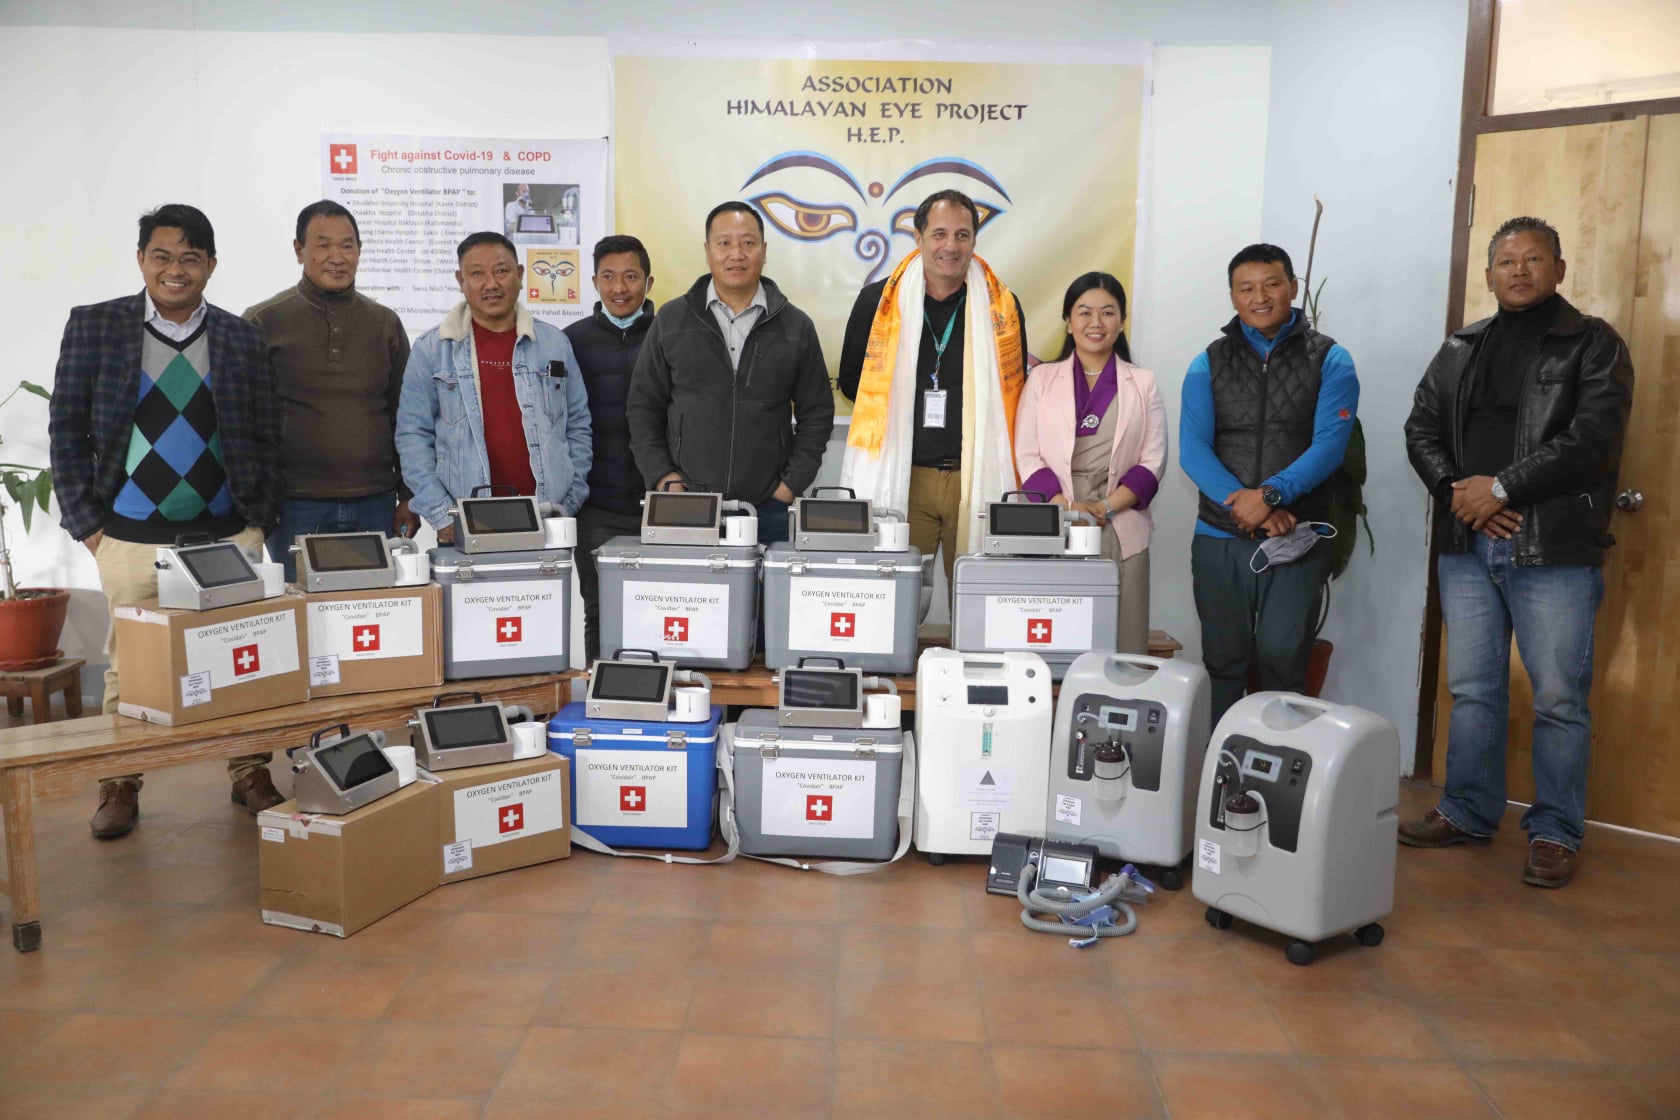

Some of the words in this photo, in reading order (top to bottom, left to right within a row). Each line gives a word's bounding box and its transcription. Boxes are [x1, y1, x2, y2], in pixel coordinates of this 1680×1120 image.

[801, 76, 952, 95] ASSOCIATION
[727, 100, 867, 118] HIMALAYAN
[881, 102, 923, 120] EYE
[936, 103, 1028, 123] PROJECT
[847, 127, 904, 144] H.E.P.
[370, 150, 399, 162] Fight
[401, 150, 440, 162] against
[444, 150, 493, 161] Covid-19
[504, 152, 511, 162] &
[518, 152, 551, 162] COPD
[382, 166, 412, 174] Chronic
[414, 166, 458, 175] obstructive
[460, 166, 502, 176] pulmonary
[504, 167, 536, 175] disease
[382, 188, 408, 196] "Oxygen
[318, 603, 350, 612] OXYGEN
[353, 600, 398, 609] VENTILATOR
[198, 626, 228, 639] OXYGEN
[231, 616, 274, 631] VENTILATOR
[275, 614, 286, 622] KIT
[808, 773, 852, 781] VENTILATOR
[466, 786, 496, 798] OXYGEN
[498, 776, 540, 791] VENTILATOR
[541, 774, 552, 782] KIT
